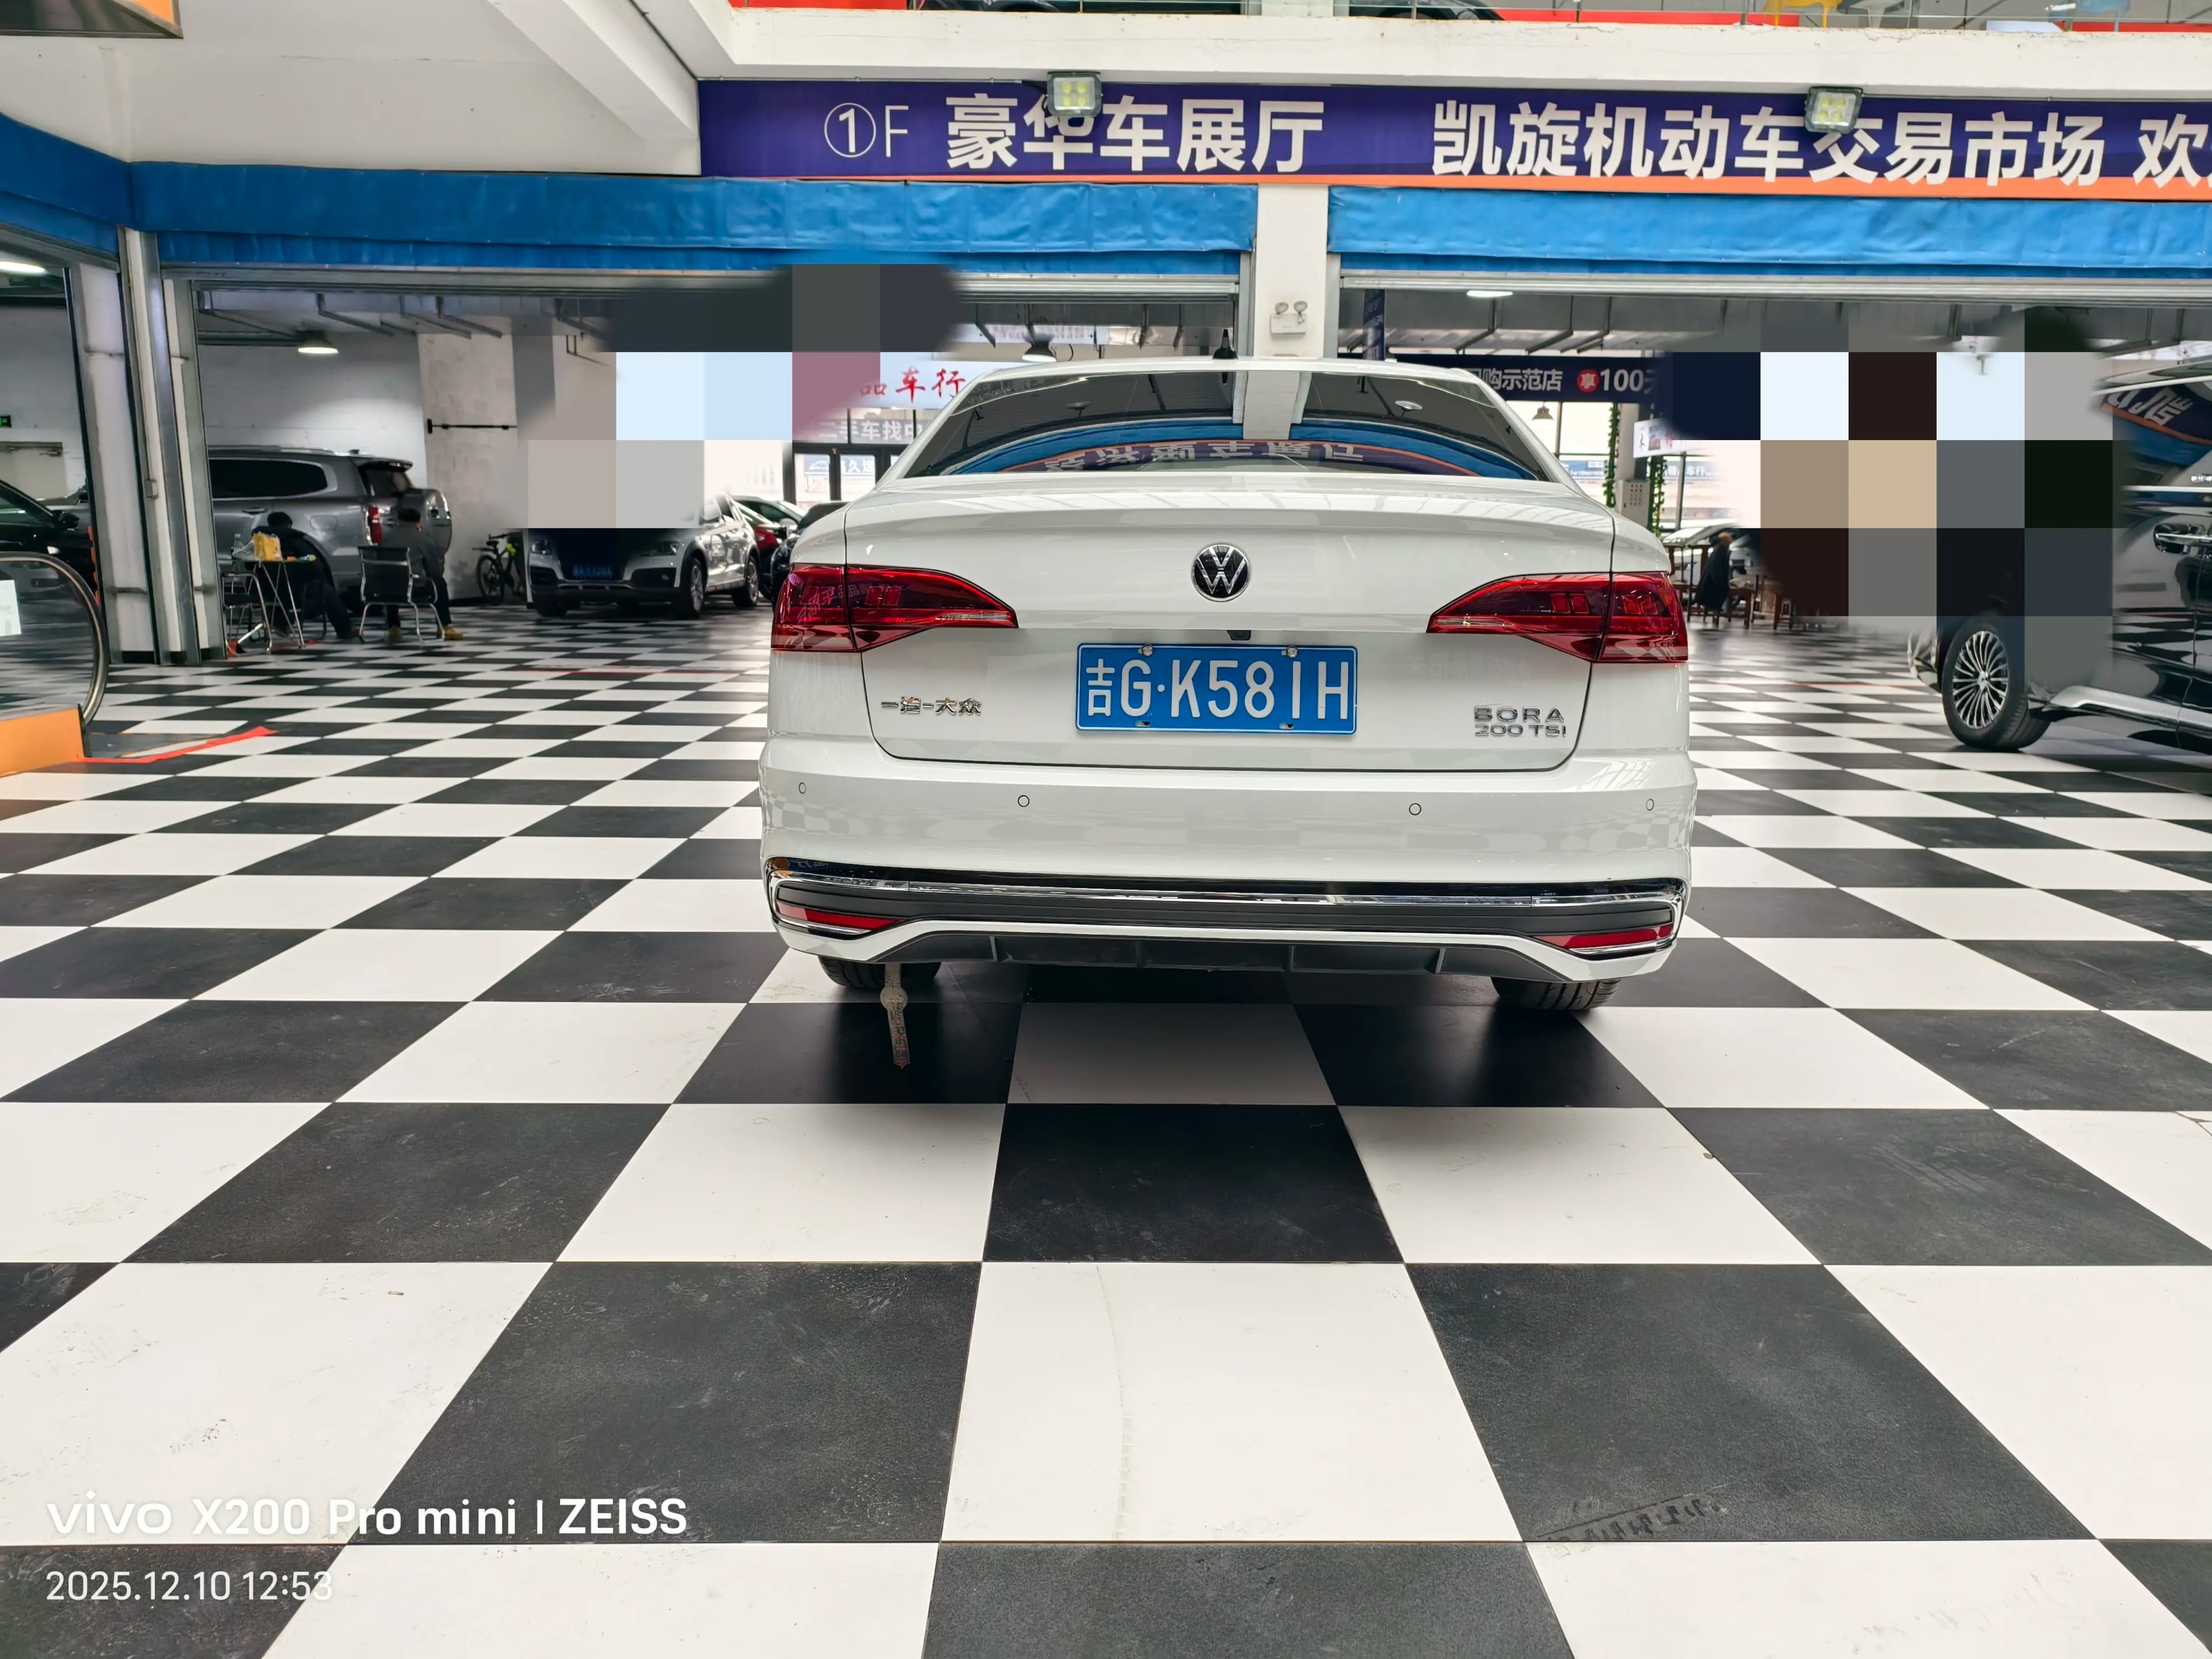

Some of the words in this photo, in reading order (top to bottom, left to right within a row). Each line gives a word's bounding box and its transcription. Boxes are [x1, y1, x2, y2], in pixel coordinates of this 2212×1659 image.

[945, 93, 1324, 173] 豪华车展厅
[1432, 100, 2105, 187] 凯旋机动车交易市场
[2133, 113, 2212, 189] 欢
[1474, 706, 1565, 722] BORA
[1474, 723, 1524, 737] 200
[1529, 723, 1566, 737] TSI
